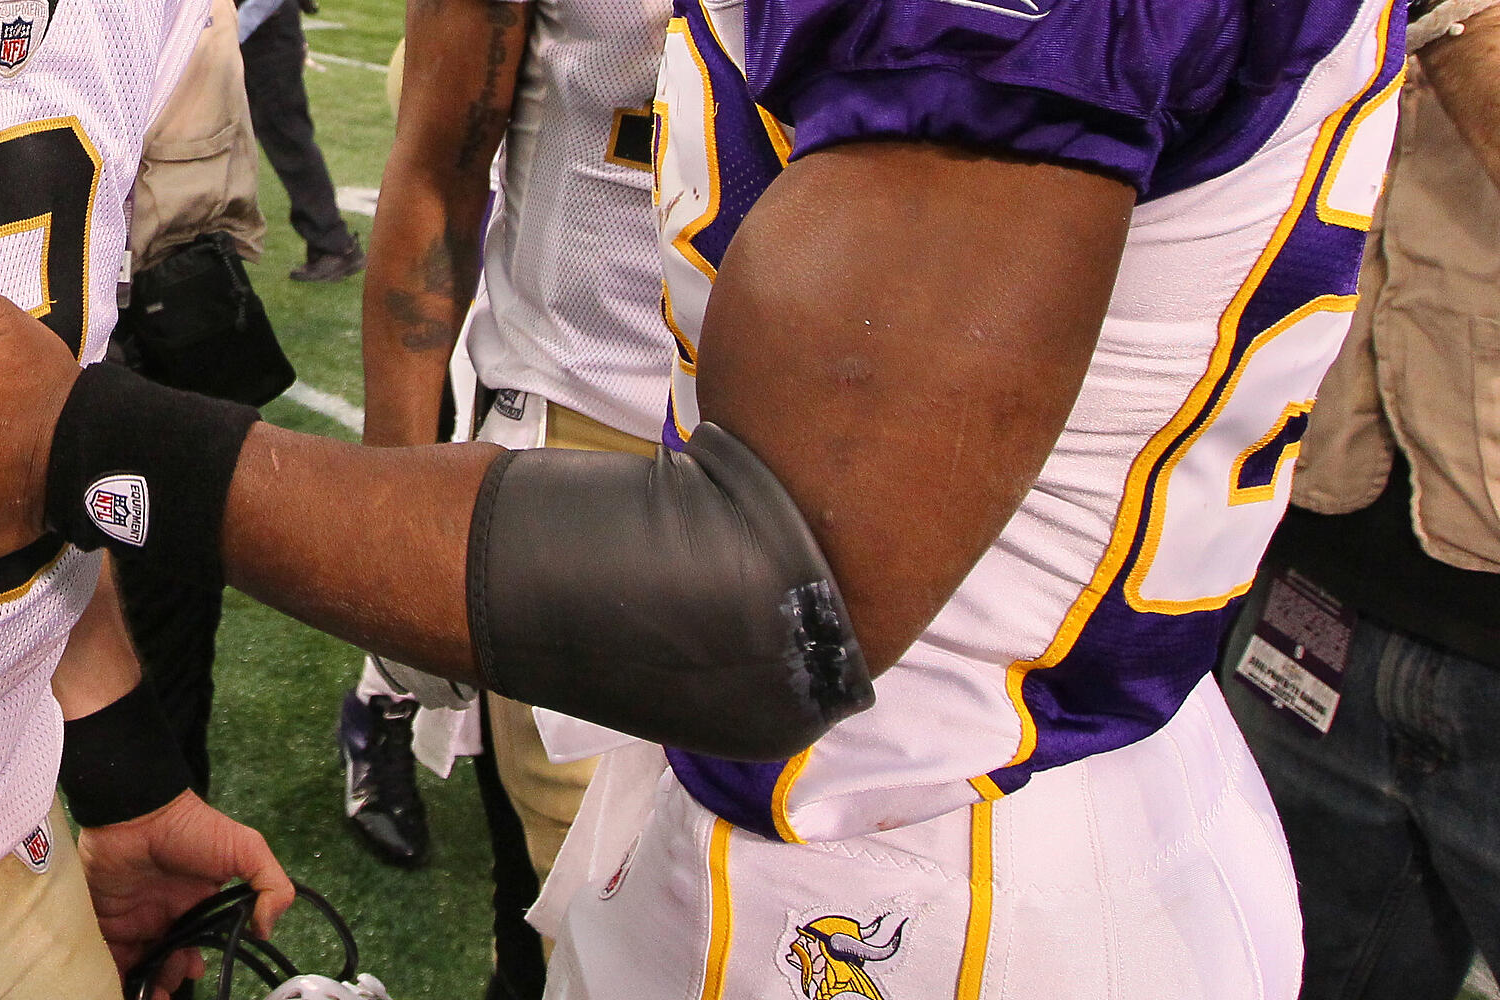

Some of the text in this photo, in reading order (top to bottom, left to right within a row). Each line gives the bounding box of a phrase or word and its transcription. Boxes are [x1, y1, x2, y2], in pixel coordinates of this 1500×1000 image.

[1, 38, 27, 63] NFL
[94, 492, 114, 520] NFL
[130, 484, 143, 541] EQUIPMENT
[28, 833, 49, 861] NFL
